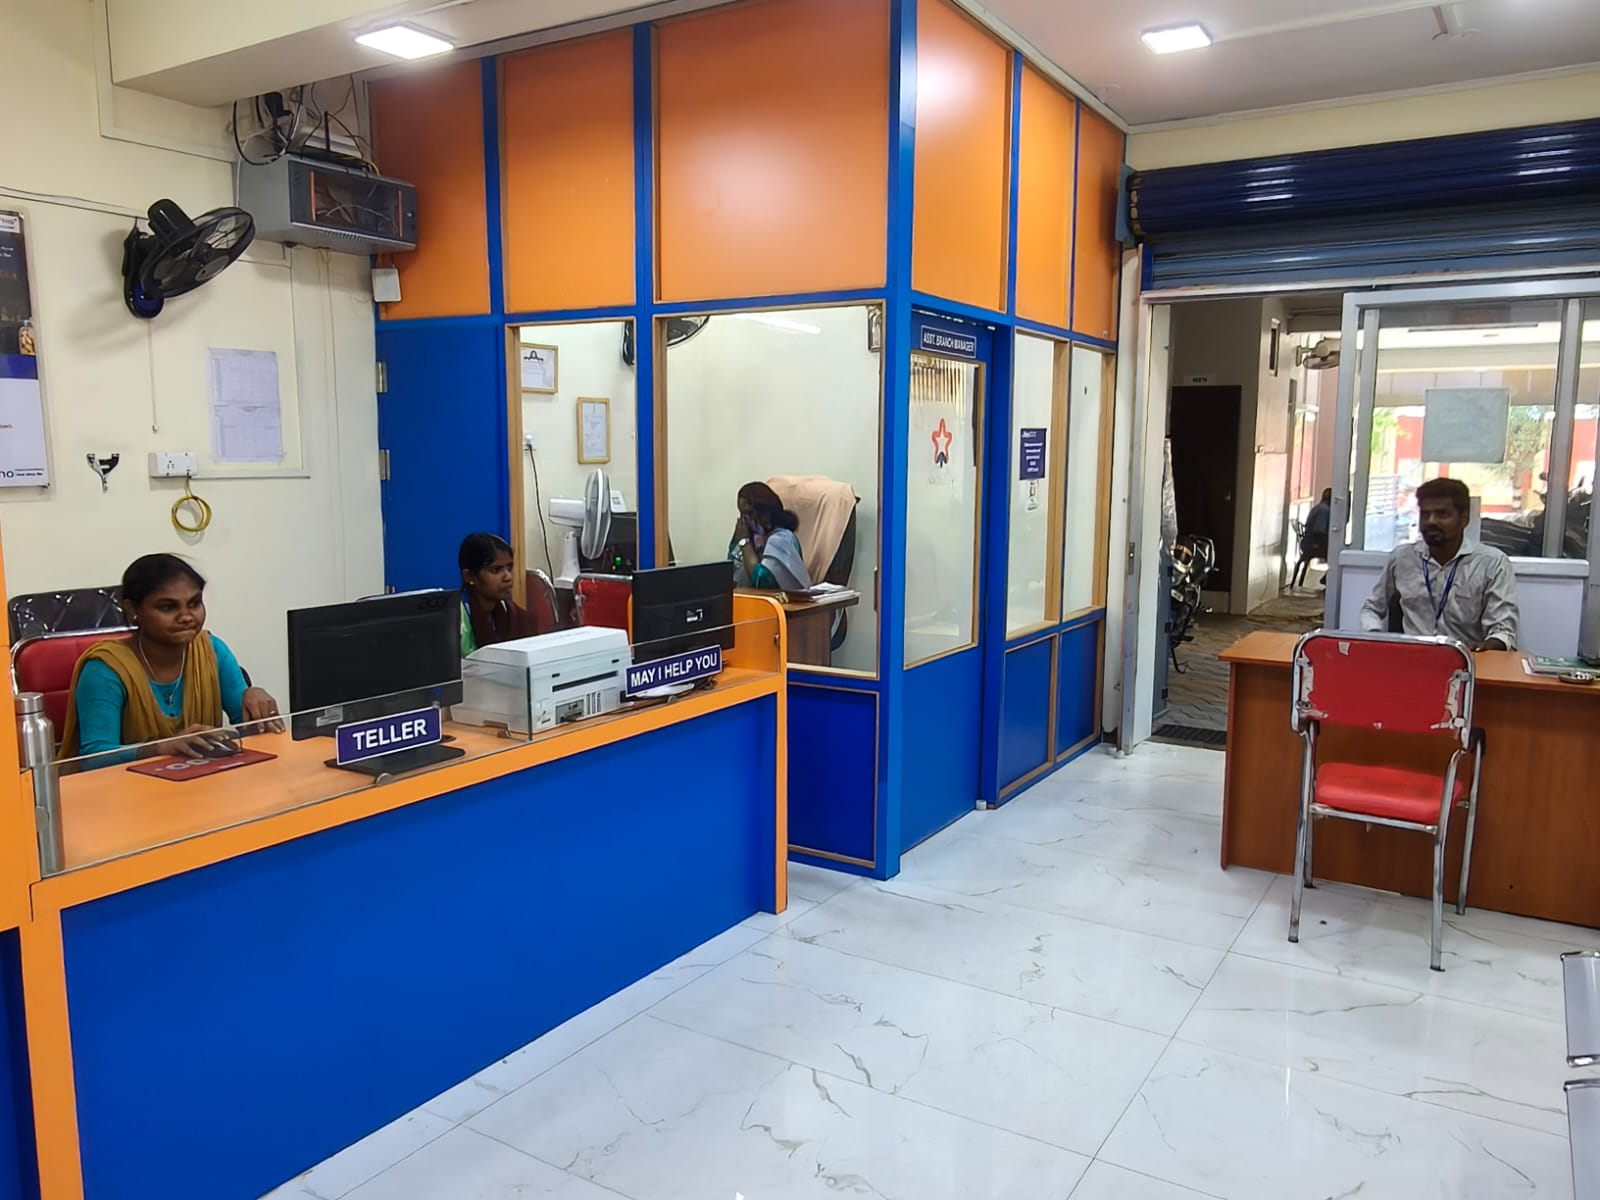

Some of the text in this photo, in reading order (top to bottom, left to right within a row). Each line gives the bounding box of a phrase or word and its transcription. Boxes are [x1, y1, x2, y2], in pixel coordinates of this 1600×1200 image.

[631, 652, 718, 688] MAY I HELP YOU
[352, 719, 428, 751] TELLER
